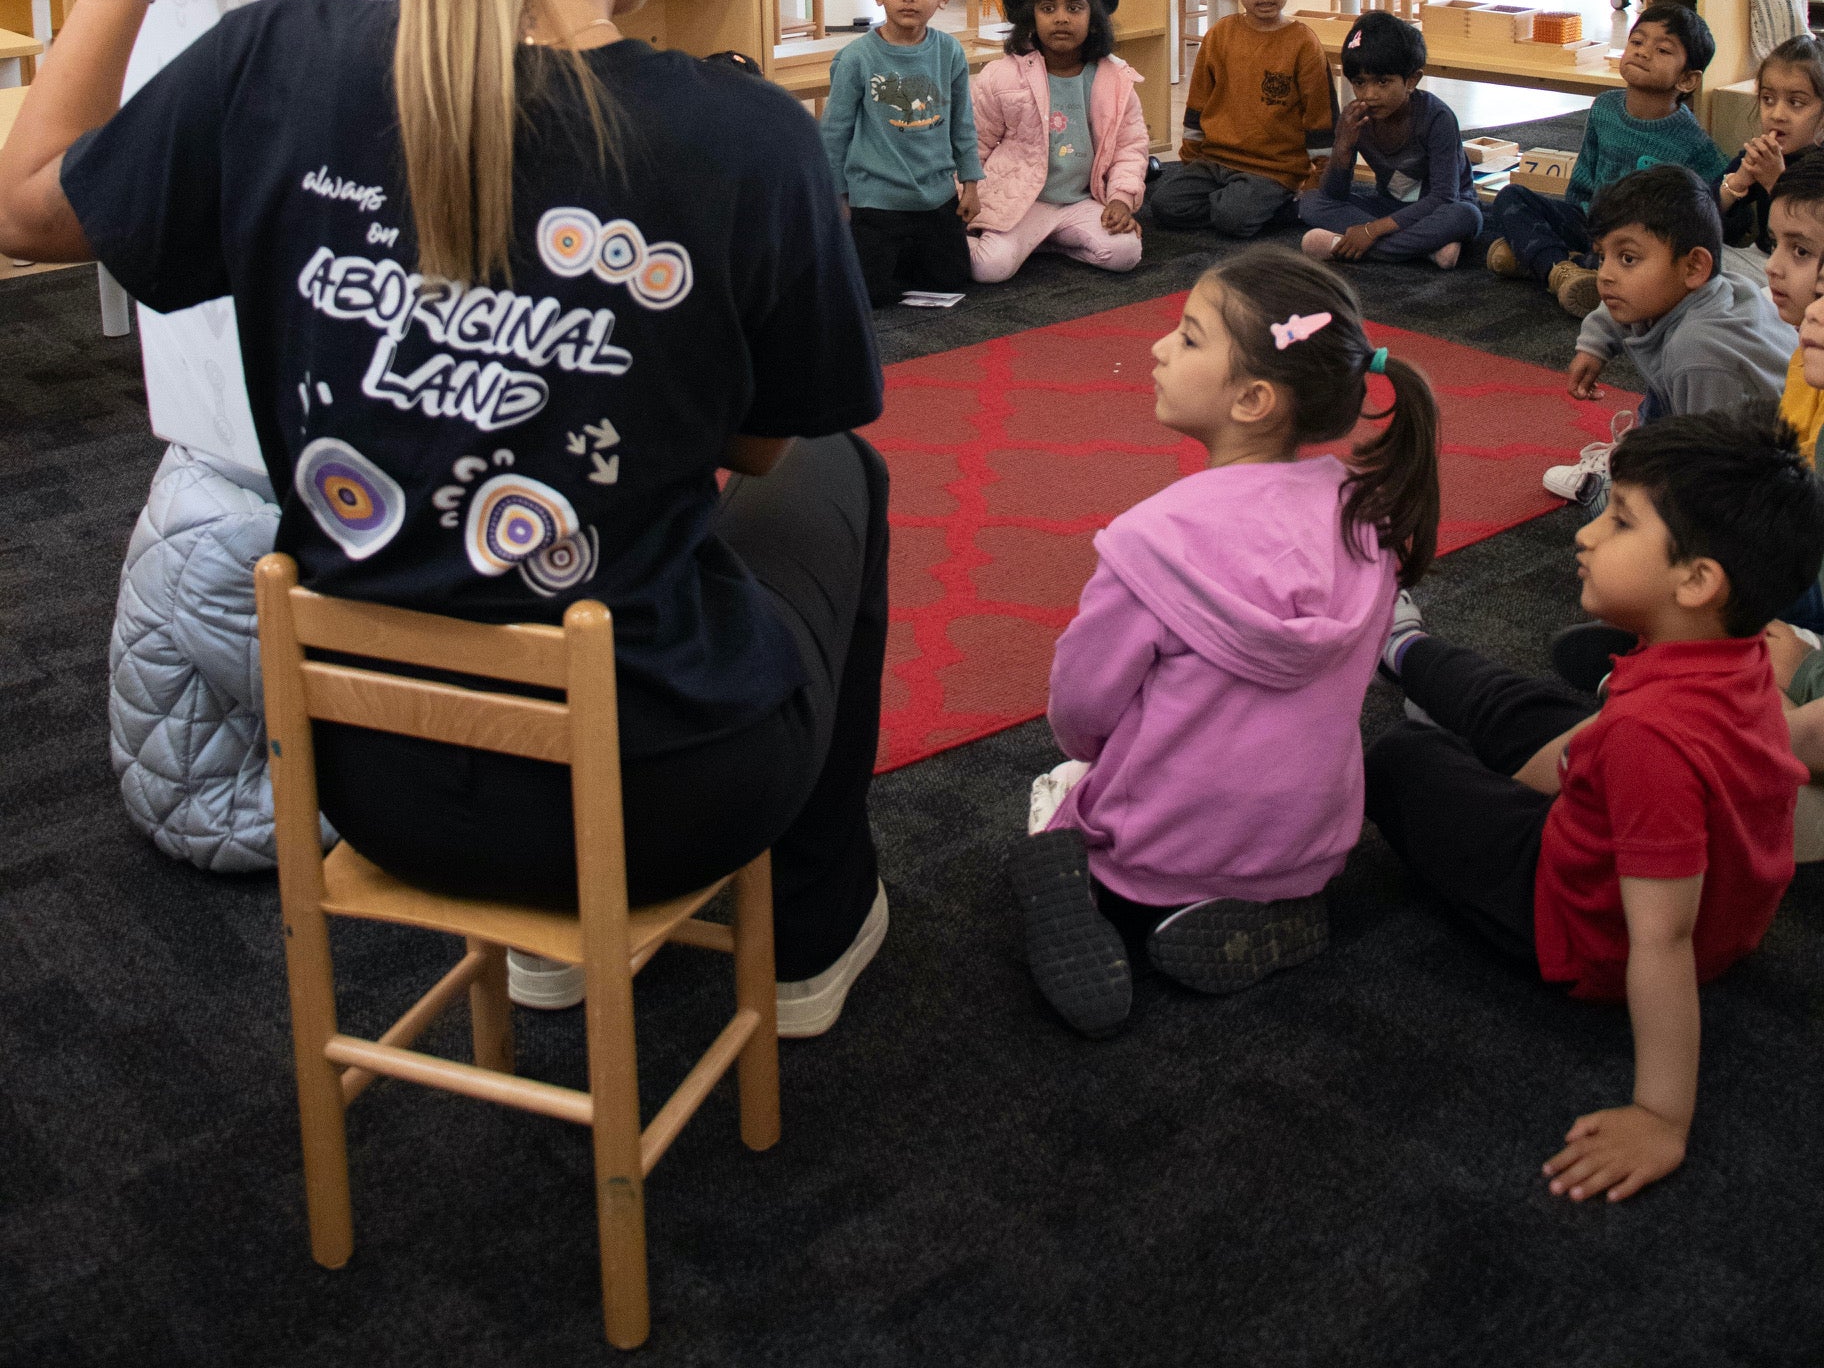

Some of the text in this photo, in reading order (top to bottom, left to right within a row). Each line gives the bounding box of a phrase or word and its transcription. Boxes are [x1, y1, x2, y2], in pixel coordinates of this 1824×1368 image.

[302, 165, 387, 212] always
[366, 221, 399, 248] on
[298, 246, 634, 376] ABORIGINAL
[361, 333, 551, 432] LAND
